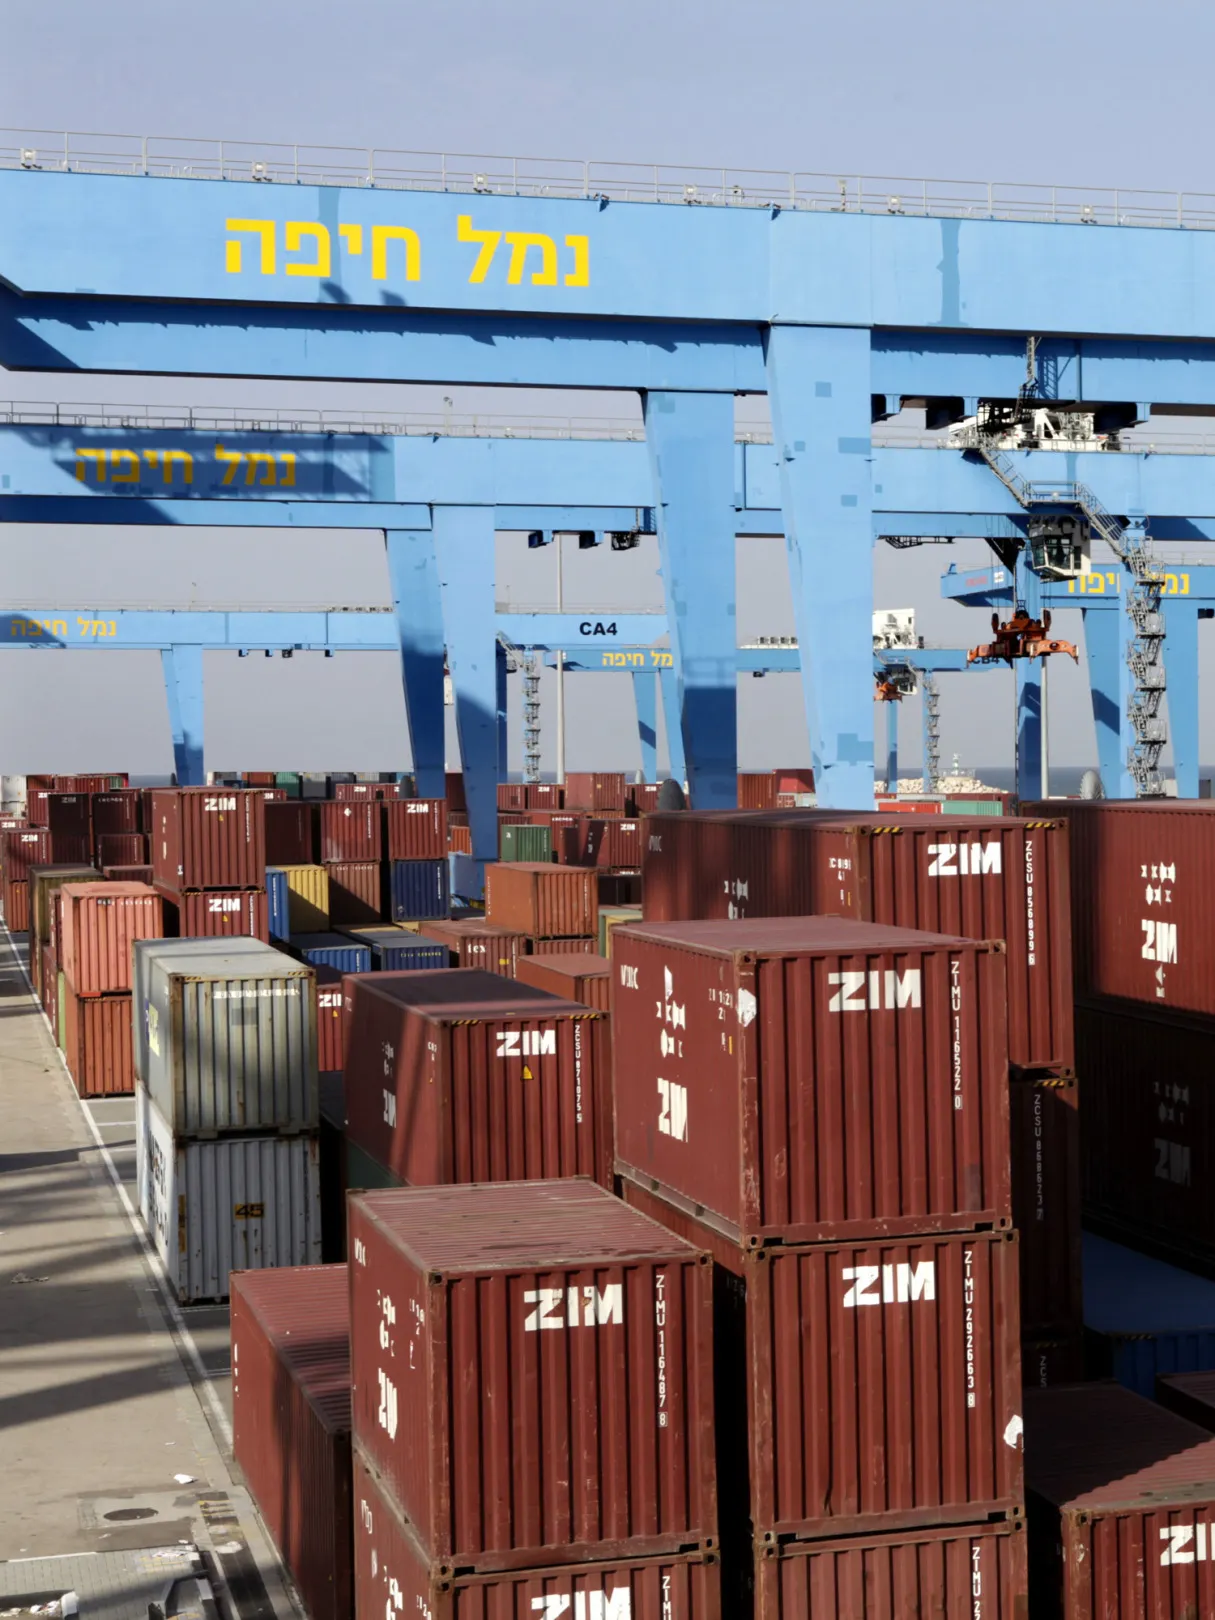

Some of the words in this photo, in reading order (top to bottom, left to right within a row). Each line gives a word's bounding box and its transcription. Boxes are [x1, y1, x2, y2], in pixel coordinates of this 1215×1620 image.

[225, 218, 421, 281] חיפה
[456, 214, 590, 287] נמל
[75, 448, 194, 484] חיפה
[215, 444, 296, 486] נמל
[11, 619, 68, 637] חיפה
[76, 616, 117, 637] נמל
[579, 621, 618, 636] CA4
[602, 652, 645, 667] חיפה
[204, 797, 237, 812] ZIM
[407, 803, 429, 814] ZIM
[928, 841, 1002, 877] ZIM
[1025, 841, 1034, 884] ZCSU
[209, 897, 241, 913] ZIM
[1027, 886, 1035, 951] 856899
[467, 943, 486, 954] tex
[1028, 953, 1036, 966] 6
[1141, 918, 1178, 965] ZIM
[828, 968, 922, 1013] ZIM
[950, 961, 961, 1011] ZIMU
[495, 1029, 556, 1057] ZIM
[953, 1016, 961, 1091] 116522
[954, 1095, 962, 1110] 0
[1034, 1094, 1042, 1137] ZCSU
[234, 1203, 265, 1218] 45
[842, 1261, 936, 1308] ZIM
[964, 1251, 974, 1304] ZIMU
[523, 1283, 624, 1332] ZIM
[656, 1274, 666, 1327] ZIMU
[966, 1308, 975, 1389] 292663
[658, 1330, 666, 1408] 116487
[658, 1411, 668, 1427] 8
[967, 1392, 976, 1409] 8
[972, 1546, 982, 1597] ZIMU
[531, 1586, 631, 1620] ZIM
